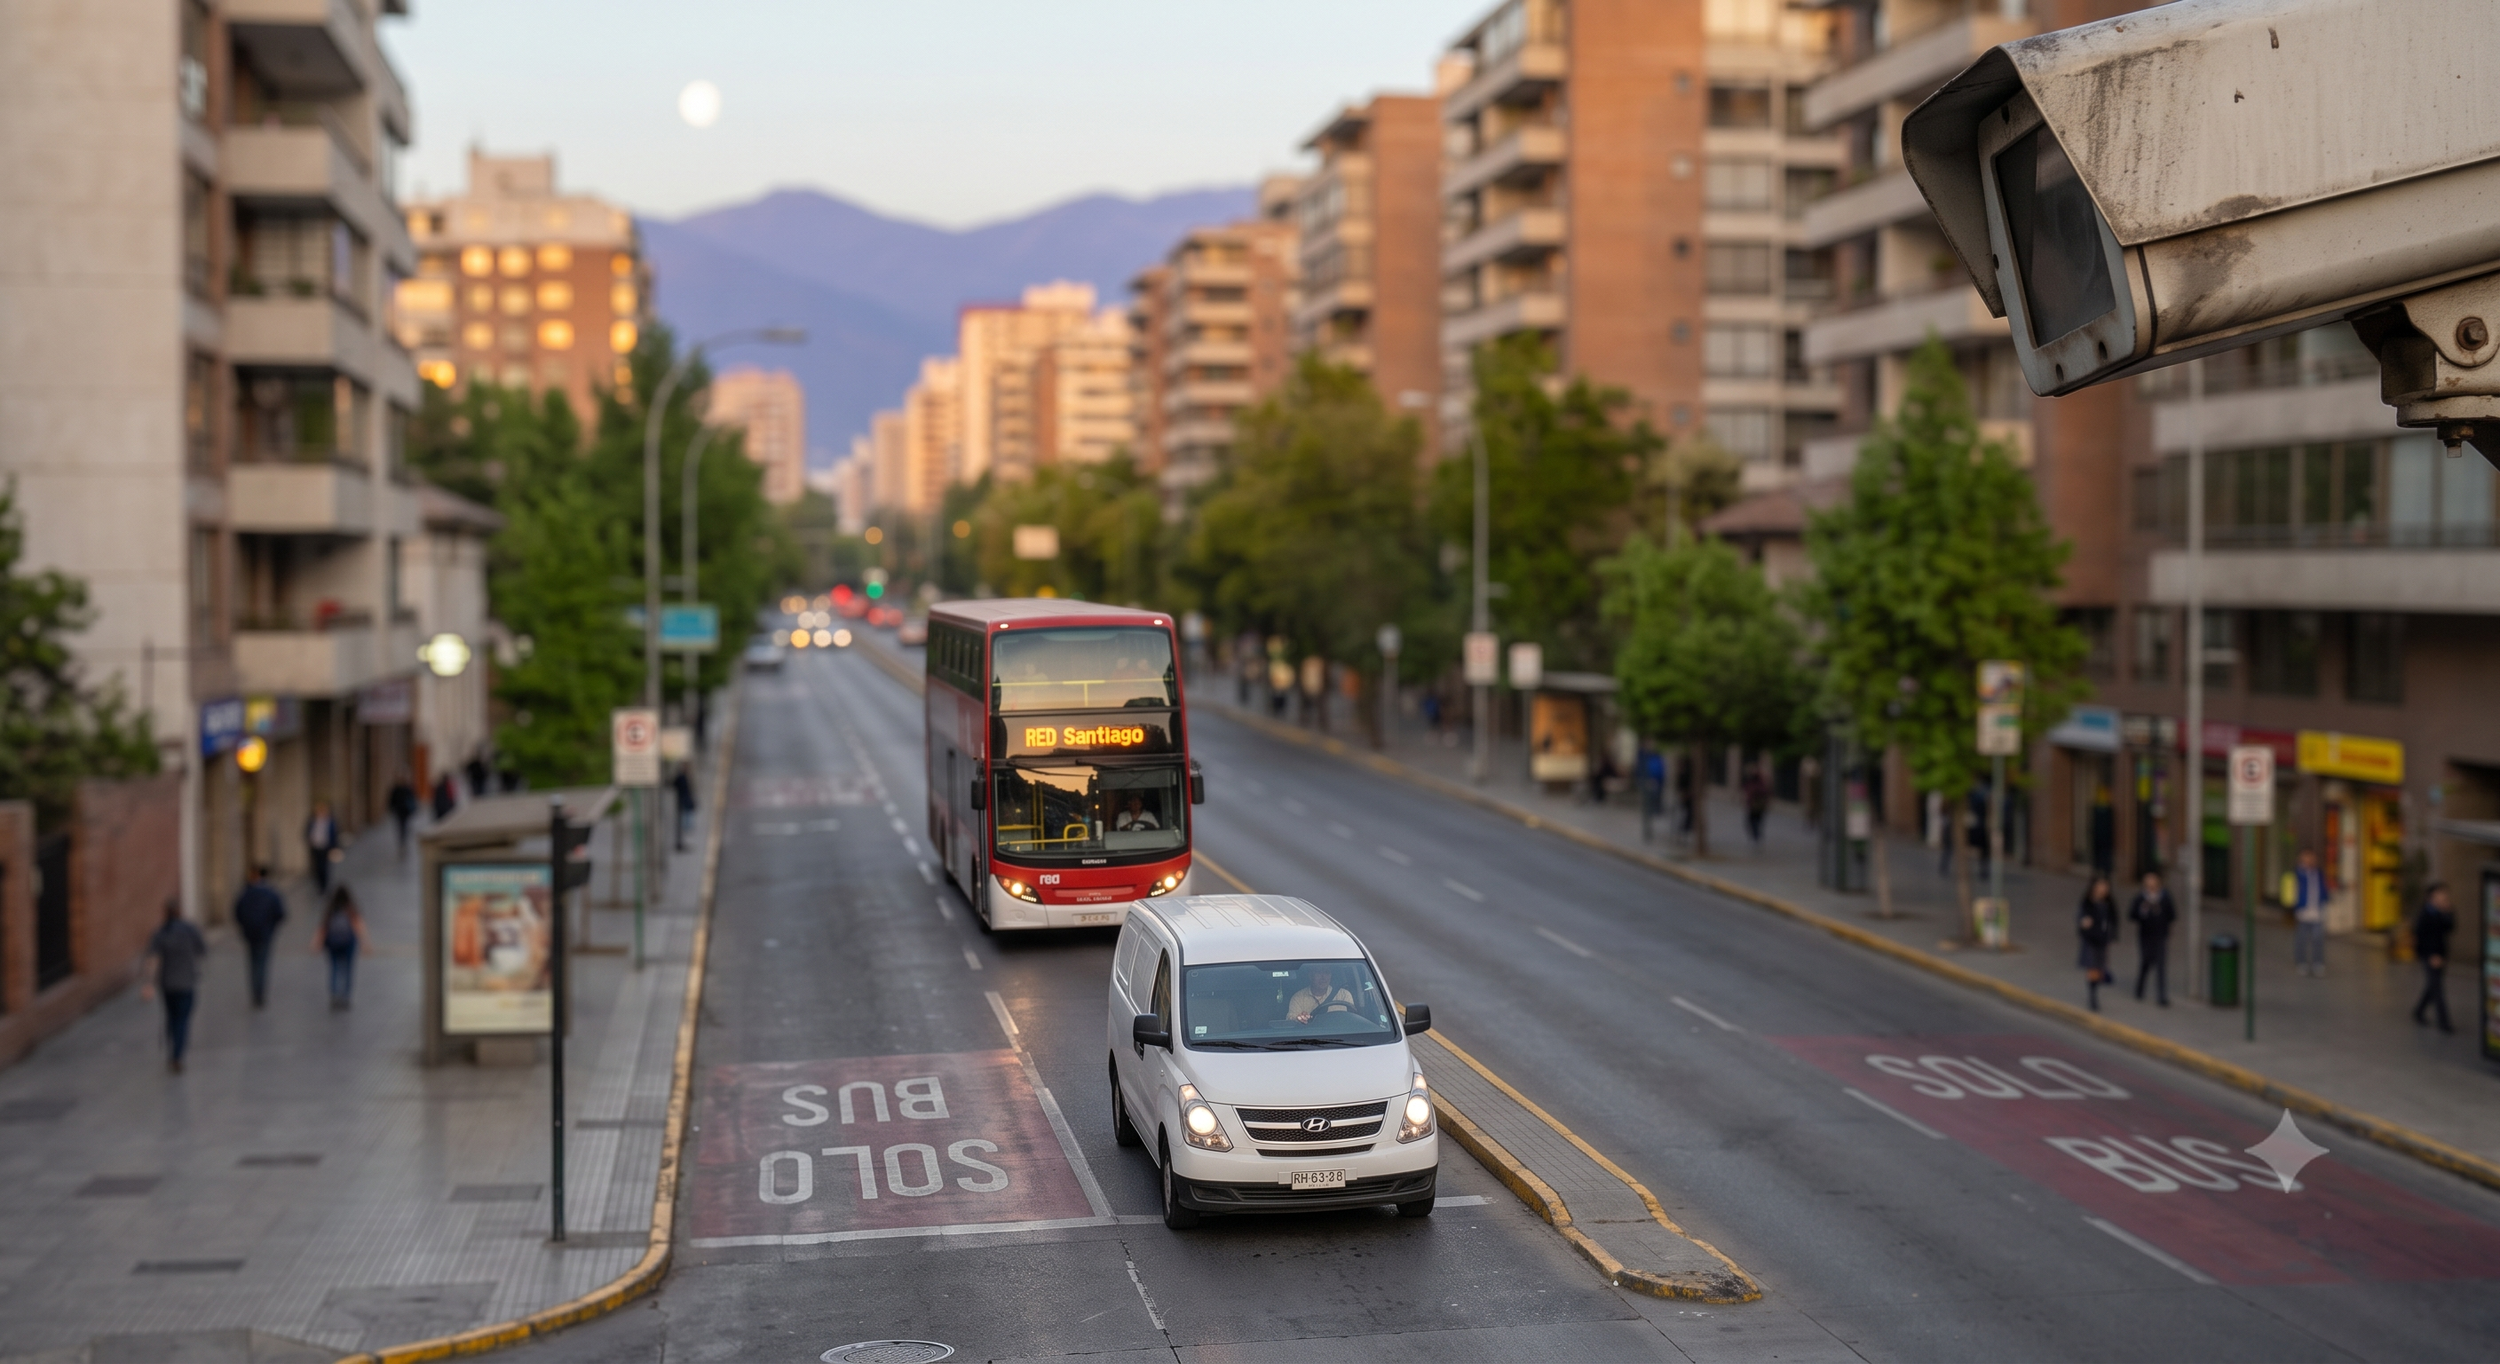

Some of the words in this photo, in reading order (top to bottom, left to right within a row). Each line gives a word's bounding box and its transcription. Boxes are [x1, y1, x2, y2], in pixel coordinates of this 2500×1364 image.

[1025, 727, 1057, 747] RED
[1063, 726, 1144, 746] Santiago
[782, 1076, 950, 1127] BUS
[1864, 1054, 2132, 1100] SOLO
[758, 1138, 1010, 1205] SOLO
[2043, 1135, 2305, 1193] BUS
